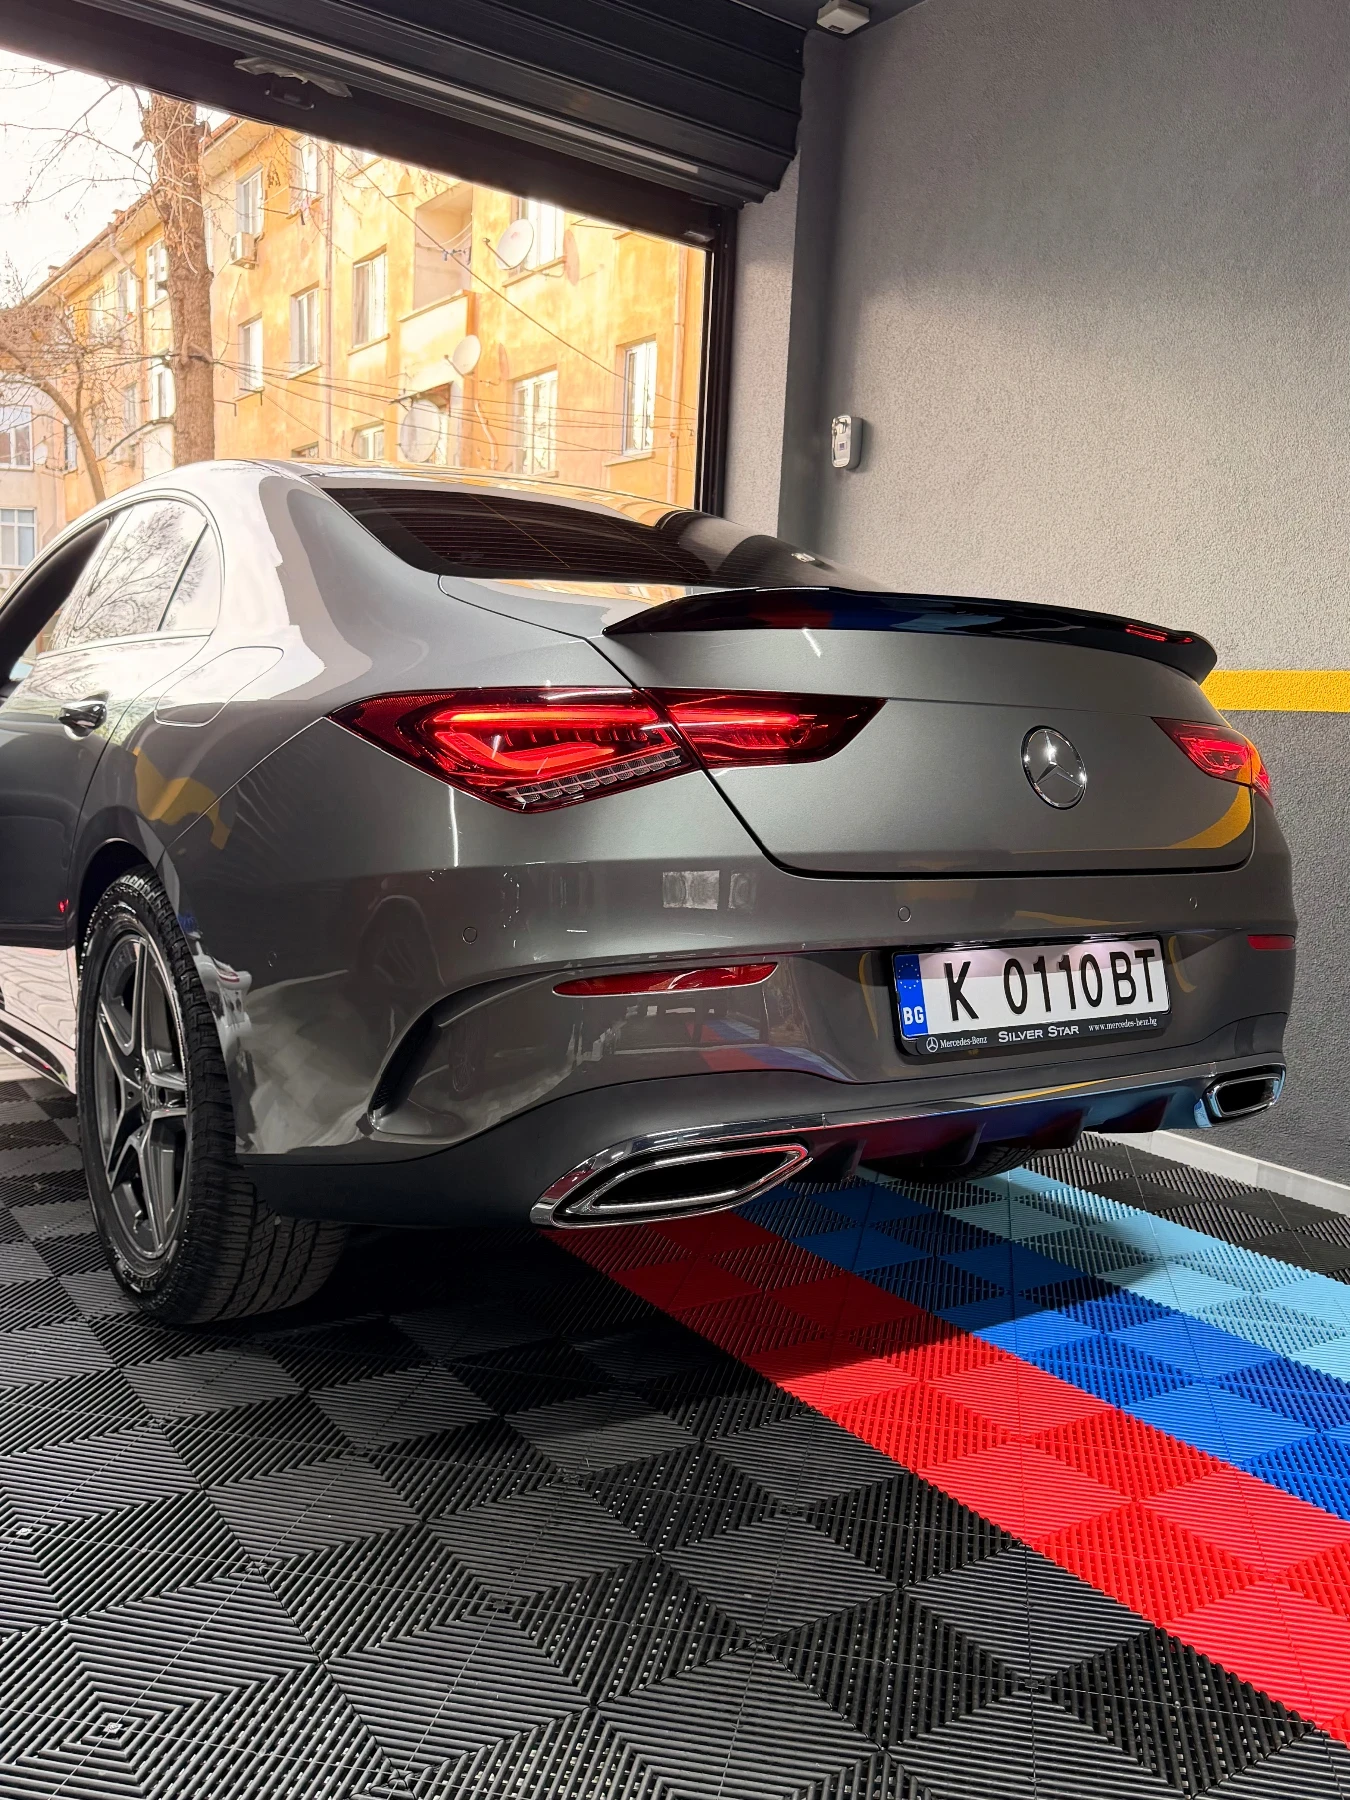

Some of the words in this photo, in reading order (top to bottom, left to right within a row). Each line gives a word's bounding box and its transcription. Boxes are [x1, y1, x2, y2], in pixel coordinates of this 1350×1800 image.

[944, 960, 979, 1021] K
[902, 1006, 924, 1025] BG
[940, 1036, 988, 1049] Mercedes-Benz
[1088, 1017, 1158, 1032] www.mercedes-benz.bg
